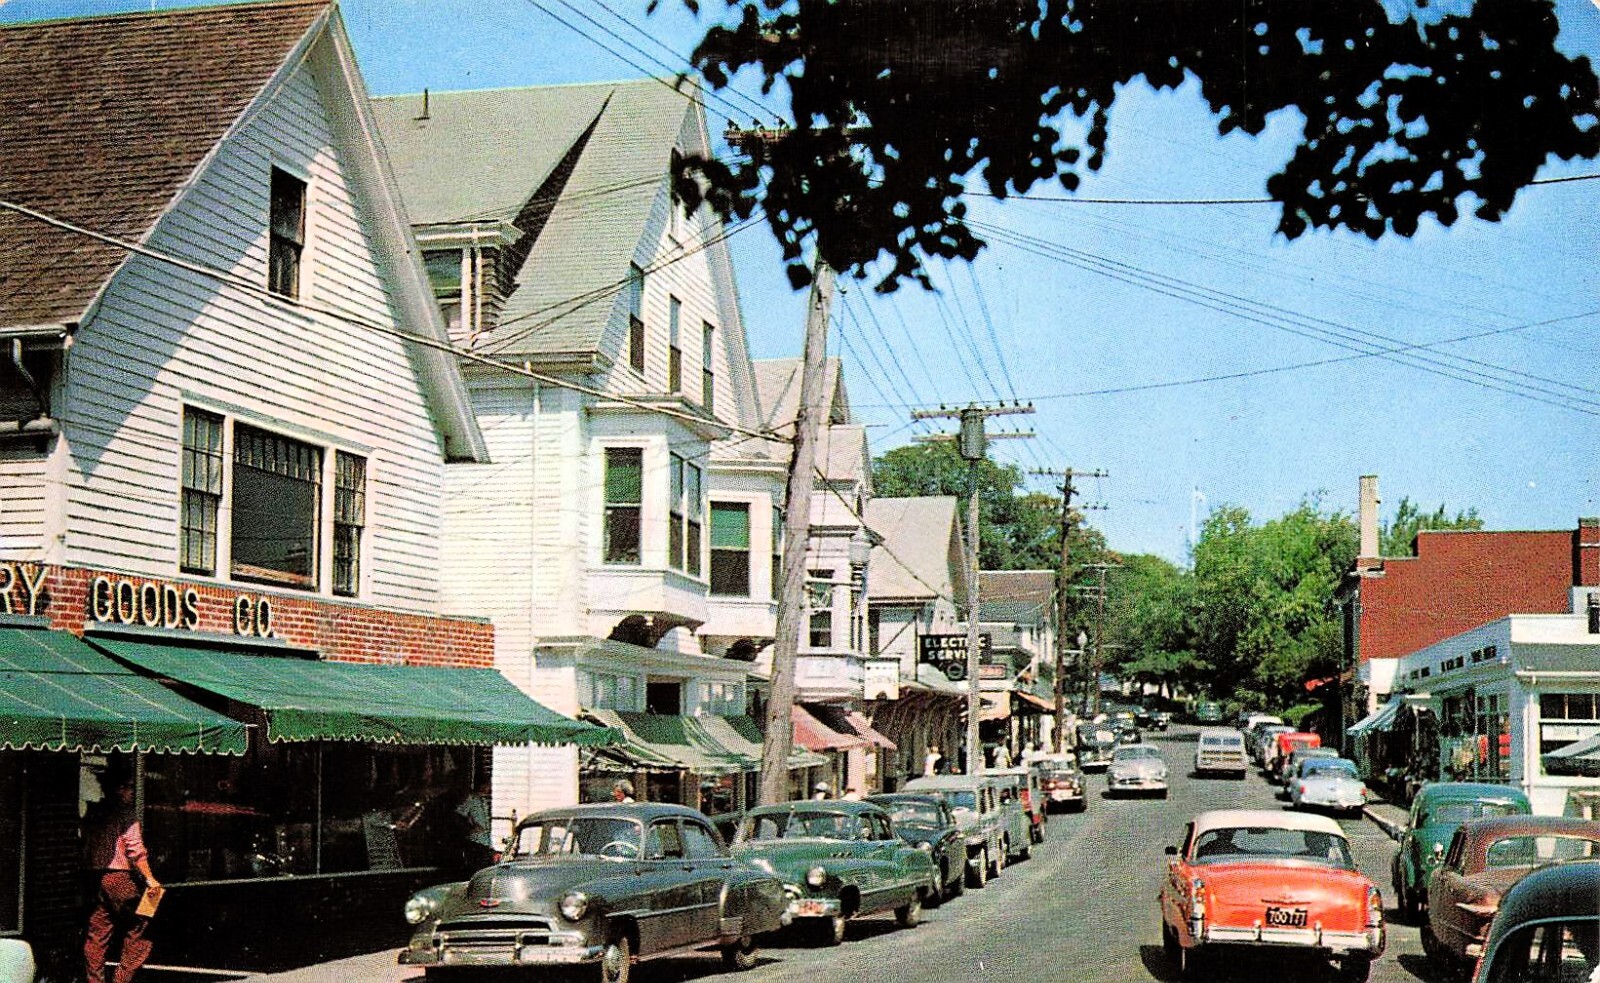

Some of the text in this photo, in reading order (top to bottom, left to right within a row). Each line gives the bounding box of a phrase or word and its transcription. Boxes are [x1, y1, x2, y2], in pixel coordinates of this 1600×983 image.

[93, 576, 200, 631] GOODS
[925, 637, 987, 648] ELECTC
[928, 649, 983, 660] SERVIE
